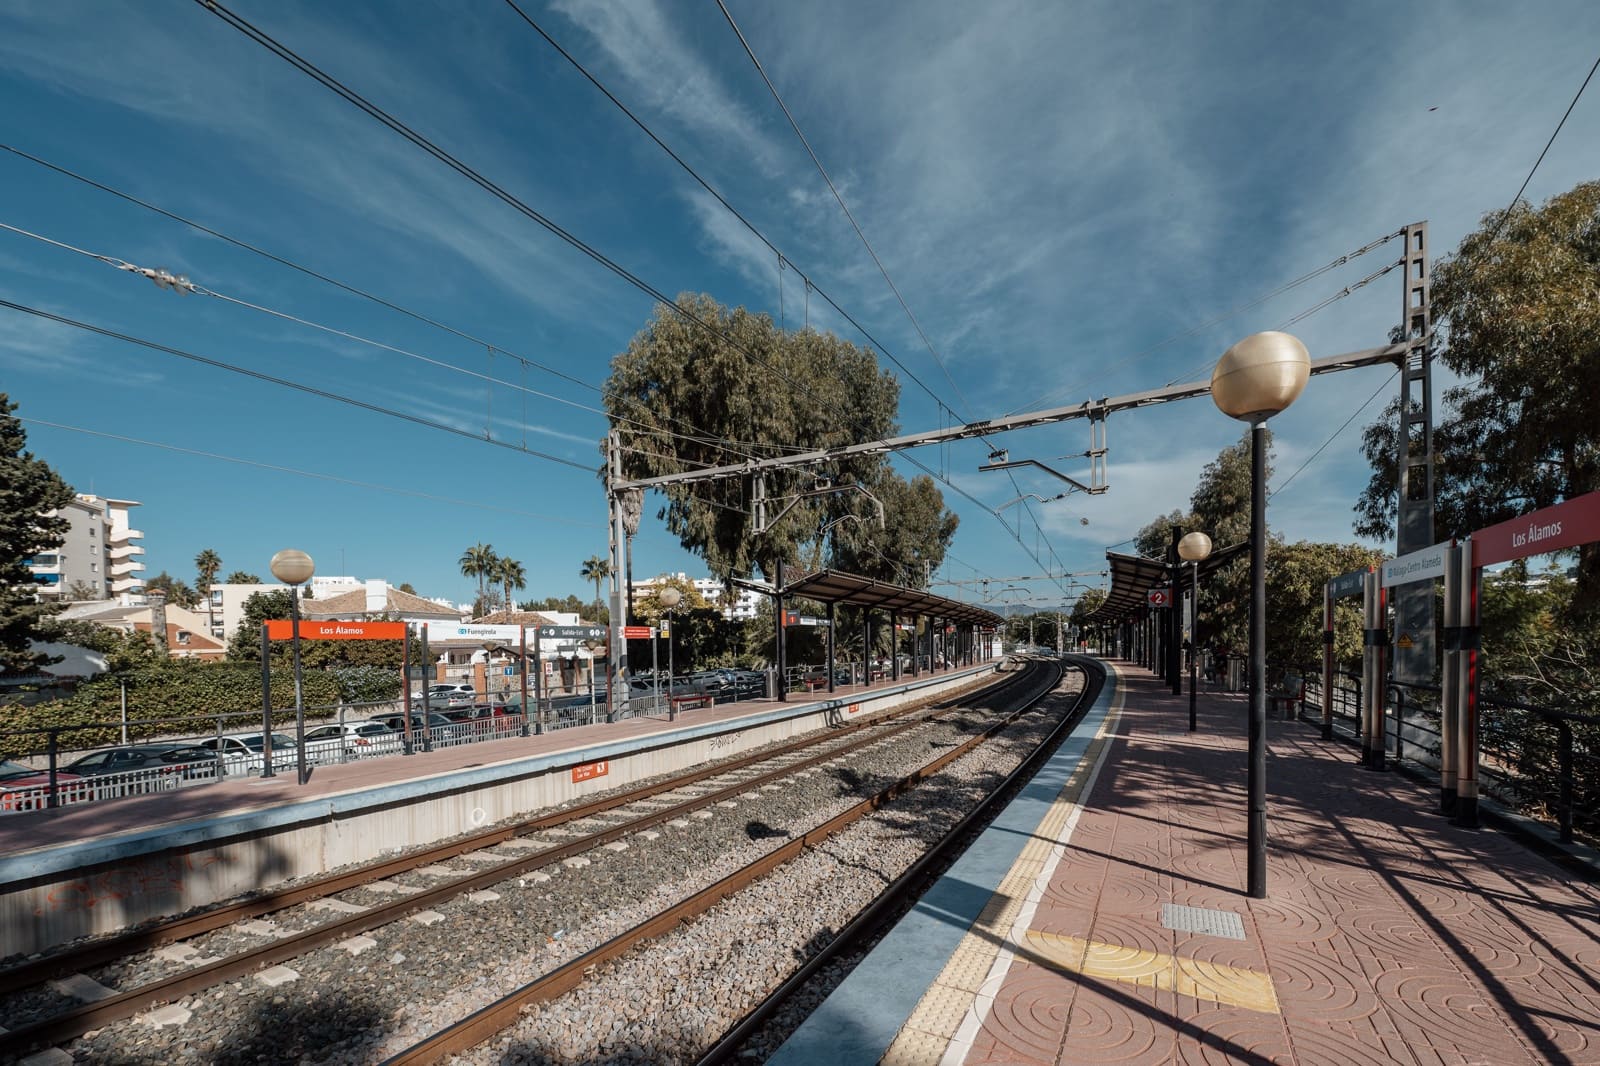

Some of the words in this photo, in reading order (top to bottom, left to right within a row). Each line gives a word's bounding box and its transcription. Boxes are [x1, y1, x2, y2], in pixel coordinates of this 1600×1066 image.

[1512, 532, 1526, 548] Los
[1528, 522, 1562, 543] Álamos
[1422, 555, 1441, 569] Alameda
[1155, 592, 1162, 604] 2
[320, 626, 334, 635] Los
[335, 625, 364, 635] Álamos
[467, 628, 497, 636] Fuengirola
